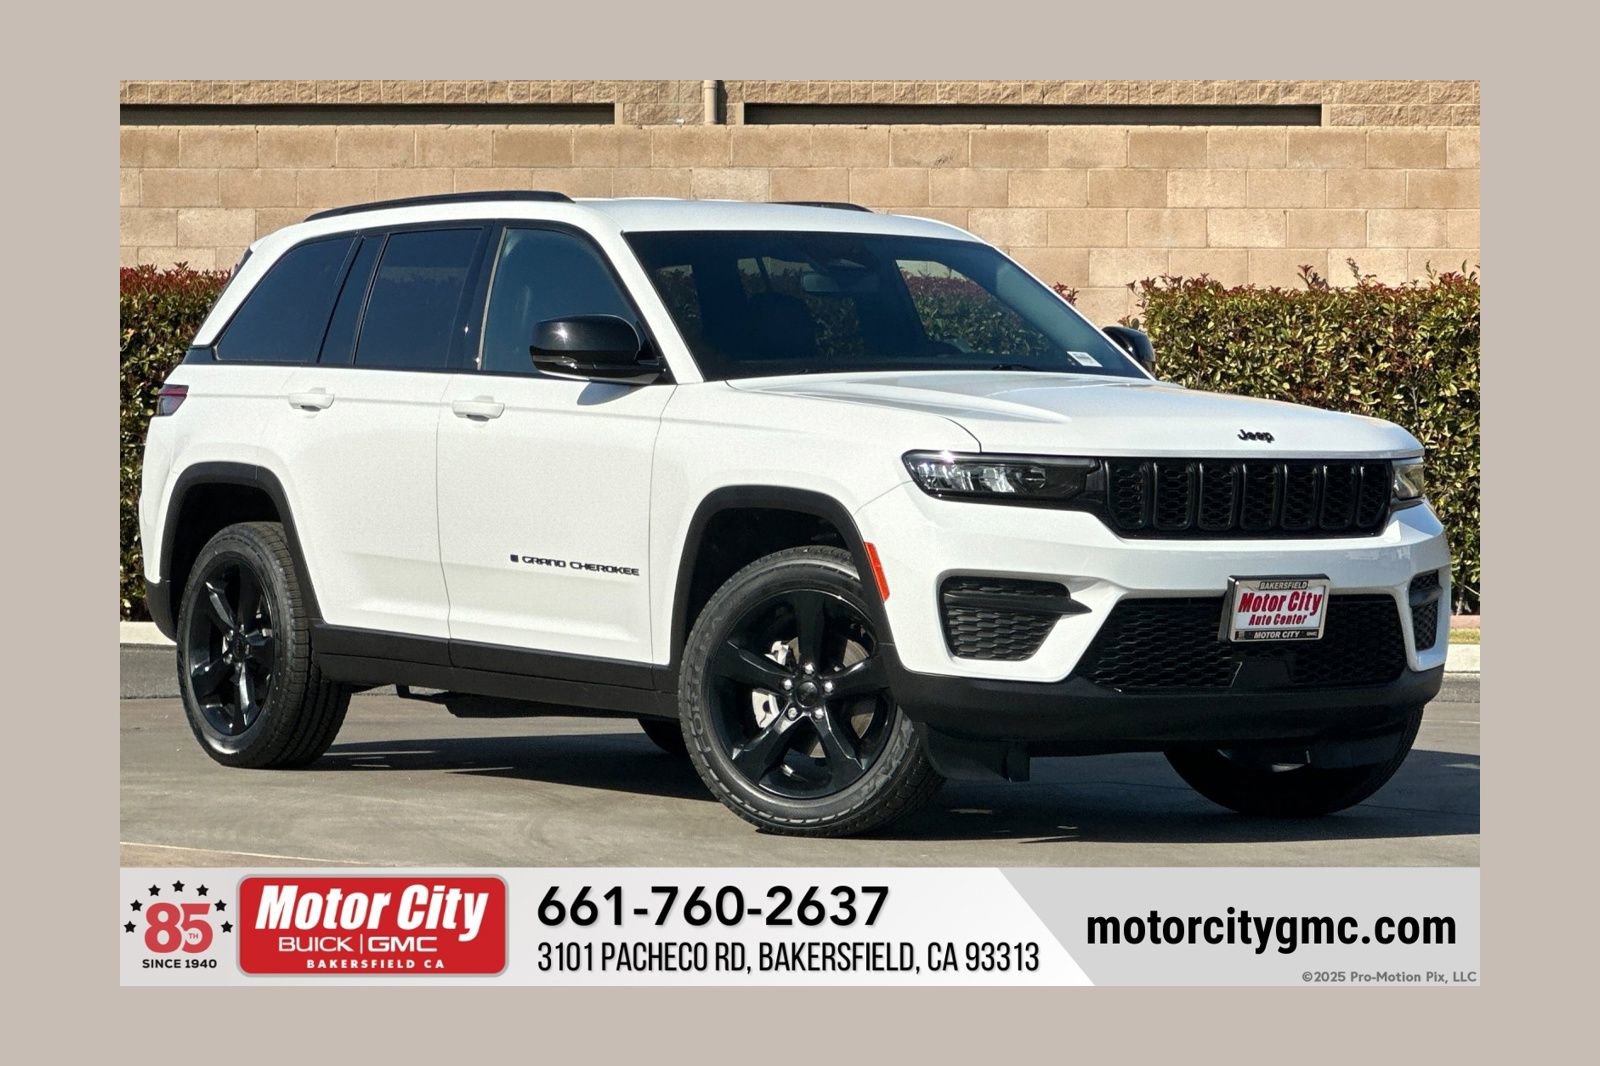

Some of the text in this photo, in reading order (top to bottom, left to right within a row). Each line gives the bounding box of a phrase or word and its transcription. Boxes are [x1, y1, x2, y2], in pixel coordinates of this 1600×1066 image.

[1237, 428, 1275, 444] Jeep
[522, 555, 640, 576] GRAND CHEROKEE
[1260, 581, 1308, 590] BAKERSFIELD
[1238, 591, 1322, 616] Motor City
[1248, 613, 1307, 626] Auto Center
[1253, 631, 1281, 639] MOTOR
[1281, 630, 1301, 639] CITY
